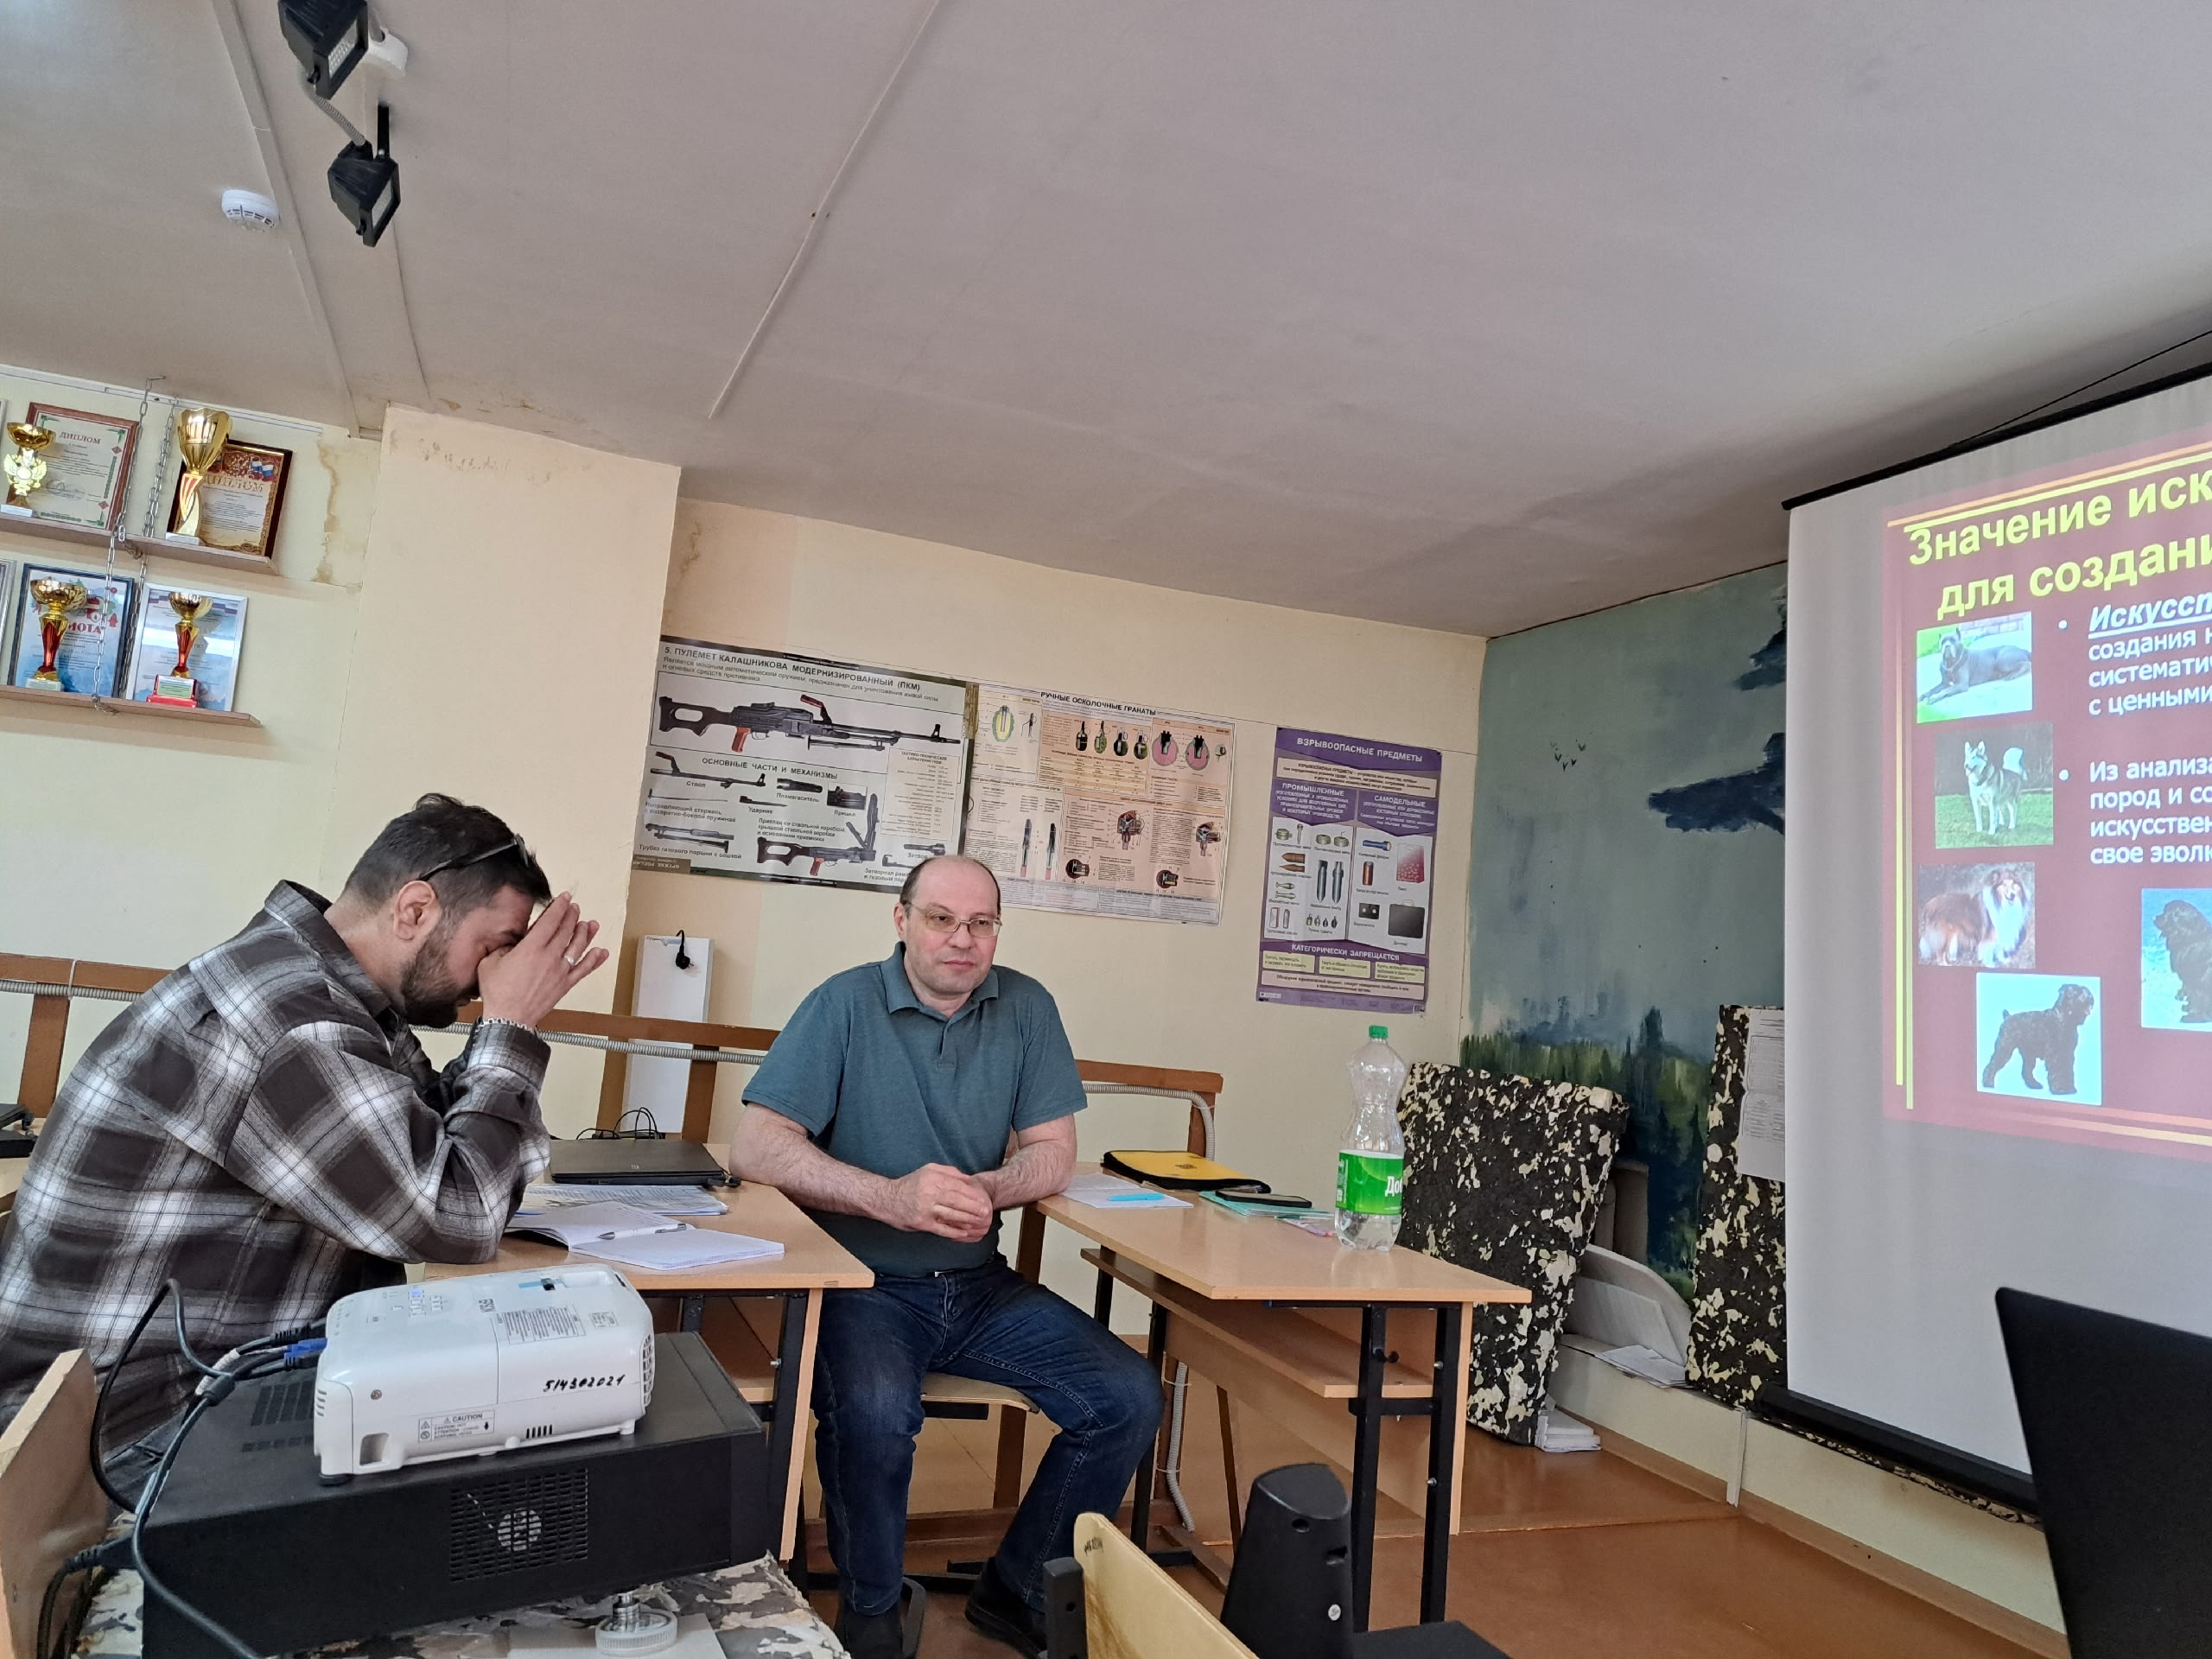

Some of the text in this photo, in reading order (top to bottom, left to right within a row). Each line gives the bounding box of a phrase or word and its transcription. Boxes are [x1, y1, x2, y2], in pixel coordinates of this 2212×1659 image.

[59, 432, 101, 444] ДИПЛОМ
[1909, 495, 2112, 565] Значение
[1937, 574, 2014, 620] для
[2088, 630, 2196, 661] создания
[675, 648, 716, 660] ПУЛЕМЕТ
[719, 655, 788, 671] КАЛАШНИКОВА
[792, 664, 893, 687] МОДЕРНИЗИРОВАННЫЙ
[897, 681, 920, 691] (ПКМ)
[2088, 656, 2212, 688] системати
[1040, 691, 1071, 702] РУЧНЫЕ
[1072, 696, 1122, 711] ОСКОЛОЧНЫЕ
[1124, 705, 1156, 715] ГРАНАТЫ
[2088, 685, 2212, 715] с ценными
[1297, 737, 1423, 762] ВЗРЫВООПАСНЫЕ ПРЕДМЕТЫ
[702, 758, 748, 769] ОСНОВНЫЕ
[752, 763, 777, 772] ЧАСТИ
[790, 768, 837, 779] МЕХАНИЗМЫ
[2089, 756, 2212, 783] Из анализ
[1282, 783, 1344, 797] ПРОМЫШЛЕННЫЕ
[1374, 795, 1426, 808] САМОДЕЛЬНЫЕ
[2090, 788, 2161, 813] пород
[2169, 787, 2183, 804] и
[2090, 846, 2144, 864] свое
[1292, 944, 1400, 962] КАТЕГОРИЧЕСКИ ЗАПРЕЩАЕТСЯ
[452, 1414, 483, 1422] CAUTION
